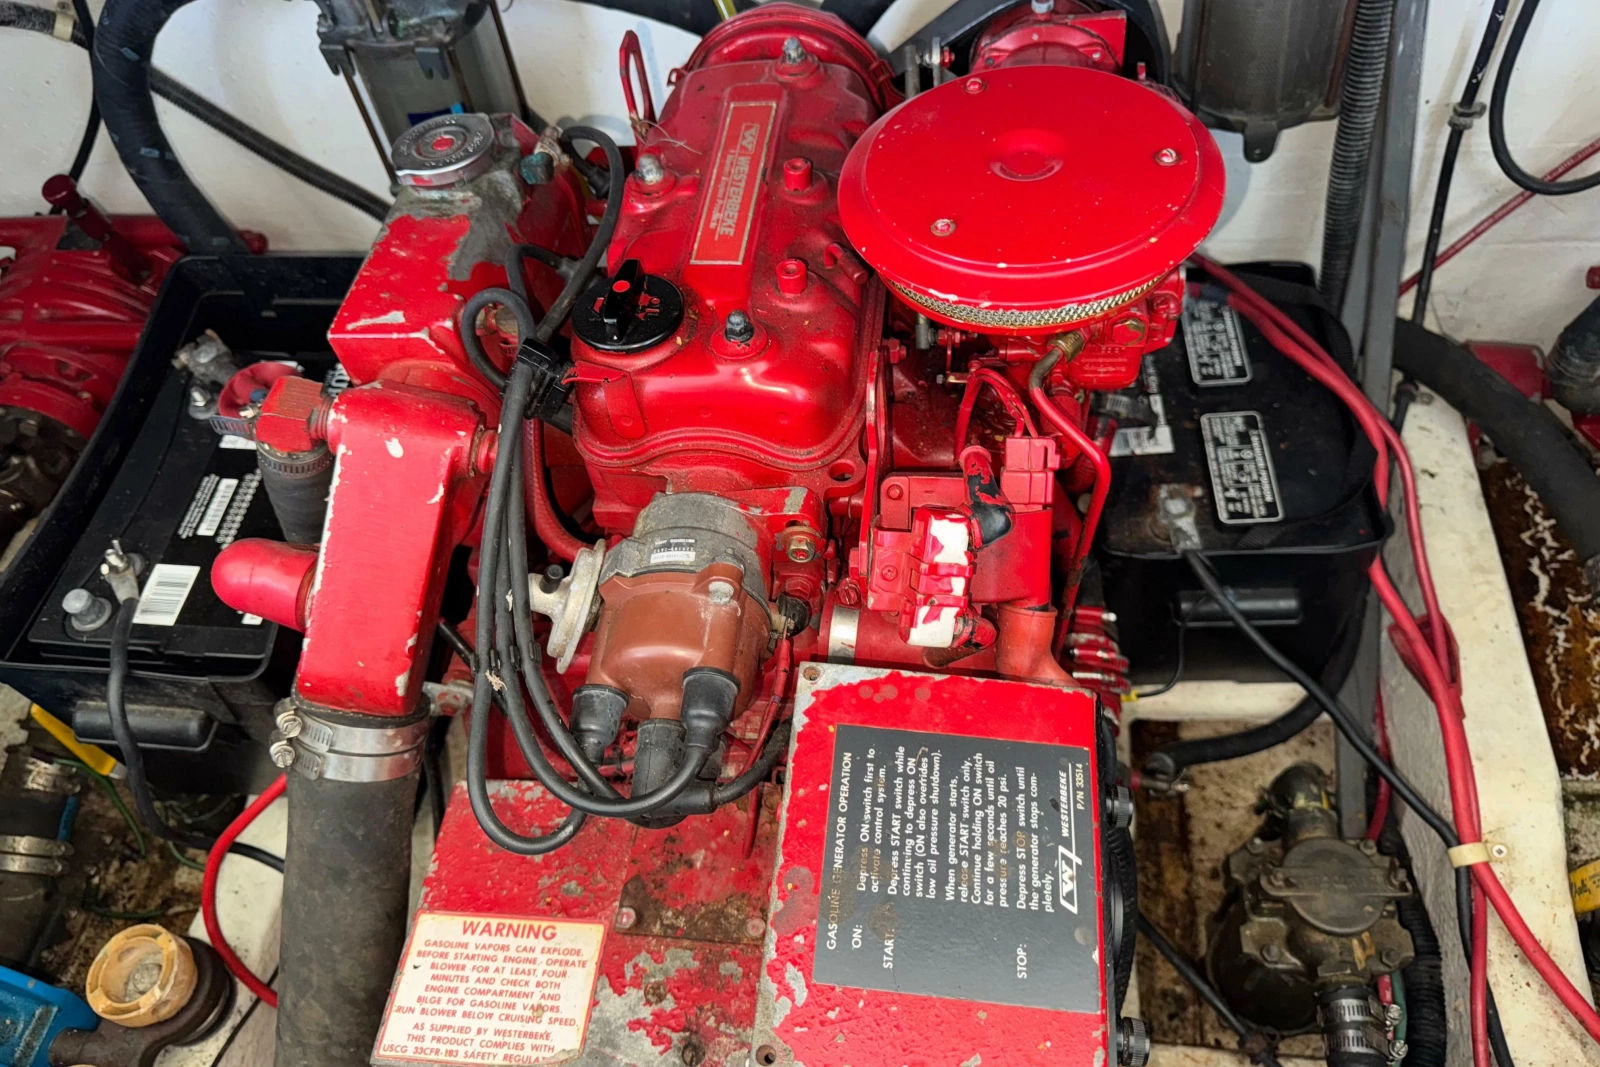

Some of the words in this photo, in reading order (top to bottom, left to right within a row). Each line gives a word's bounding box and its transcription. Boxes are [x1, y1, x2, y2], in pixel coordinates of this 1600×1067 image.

[721, 156, 750, 236] WESTERBEKE
[866, 748, 876, 758] to
[895, 746, 905, 773] while
[907, 758, 917, 775] ON
[986, 760, 995, 773] oil
[838, 752, 852, 812] OPERATION
[864, 763, 875, 783] first
[918, 757, 929, 804] overrides
[930, 749, 942, 804] shutdown).
[961, 757, 972, 782] only.
[973, 753, 983, 784] switch
[998, 773, 1009, 792] psi.
[1016, 767, 1026, 789] until
[1075, 763, 1083, 788] 33514
[876, 765, 887, 803] system.
[893, 777, 904, 809] switch
[973, 788, 982, 806] ON
[985, 777, 995, 800] until
[1029, 772, 1039, 797] com-
[862, 787, 873, 819] switch
[904, 779, 915, 819] depress
[960, 786, 970, 818] switch
[997, 795, 1008, 808] 20
[1016, 793, 1026, 827] switch
[1058, 771, 1069, 837] WESTERBEKE
[1075, 791, 1084, 810] P/N
[873, 807, 884, 844] control
[903, 823, 913, 834] to
[916, 809, 926, 830] also
[984, 804, 995, 846] seconds
[1029, 801, 1040, 829] stops
[860, 824, 870, 842] ON
[890, 813, 901, 846] START
[928, 809, 939, 855] pressure
[947, 812, 958, 864] generator
[959, 823, 969, 856] START
[972, 810, 983, 850] holding
[997, 806, 1009, 854] reaches
[831, 816, 846, 883] GENERATOR
[914, 834, 925, 857] (ON
[1016, 830, 1026, 859] STOP
[856, 847, 868, 891] Depress
[869, 848, 881, 893] activate
[887, 850, 899, 895] Depress
[901, 838, 913, 896] continuing
[927, 859, 937, 874] oil
[984, 851, 994, 872] few
[1029, 833, 1040, 887] generator
[913, 862, 924, 897] switch
[925, 878, 936, 899] low
[945, 869, 956, 901] When
[958, 860, 969, 902] release
[970, 854, 982, 904] Continue
[985, 876, 994, 884] a
[997, 858, 1008, 907] pressure
[1016, 864, 1027, 909] Depress
[1042, 870, 1054, 912] pletely.
[983, 888, 994, 905] for
[1029, 892, 1040, 910] the
[463, 920, 558, 939] WARNING
[825, 888, 840, 949] GASOLINE
[424, 939, 469, 949] GASOLINE
[475, 943, 511, 952] VAPORS
[515, 945, 536, 953] CAN
[851, 924, 863, 948] ON:
[882, 928, 895, 969] START:
[417, 950, 449, 959] BEFORE
[454, 952, 498, 962] STARTING
[546, 958, 587, 968] OPERATE
[430, 962, 466, 971] BLOWER
[471, 965, 490, 973] FOR
[493, 966, 505, 974] AT
[542, 969, 567, 978] FOUR
[1016, 943, 1027, 979] STOP:
[425, 984, 459, 994] ENGINE
[464, 987, 534, 999] COMPARTMENT
[539, 993, 561, 1001] AND
[431, 974, 469, 983] MINUTES
[475, 977, 496, 985] AND
[500, 978, 530, 987] CHECK
[535, 980, 561, 989] BOTH
[395, 1005, 415, 1014] RUN
[420, 1007, 457, 1017] BLOWER
[461, 1010, 494, 1020] BELOW
[498, 1012, 544, 1024] CRUISING
[416, 995, 442, 1006] BILGE
[446, 997, 465, 1006] FOR
[470, 999, 517, 1010] GASOLINE
[523, 1003, 562, 1013] VAPORS.
[407, 1034, 426, 1043] THIS
[430, 1035, 474, 1047] PRODUCT
[479, 1040, 524, 1051] COMPLIES
[531, 1044, 555, 1053] WITH
[413, 1023, 424, 1031] AS
[430, 1024, 472, 1034] SUPPLIED
[476, 1027, 489, 1036] BY
[383, 1044, 408, 1053] USCG
[463, 1049, 498, 1060] SAFETY
